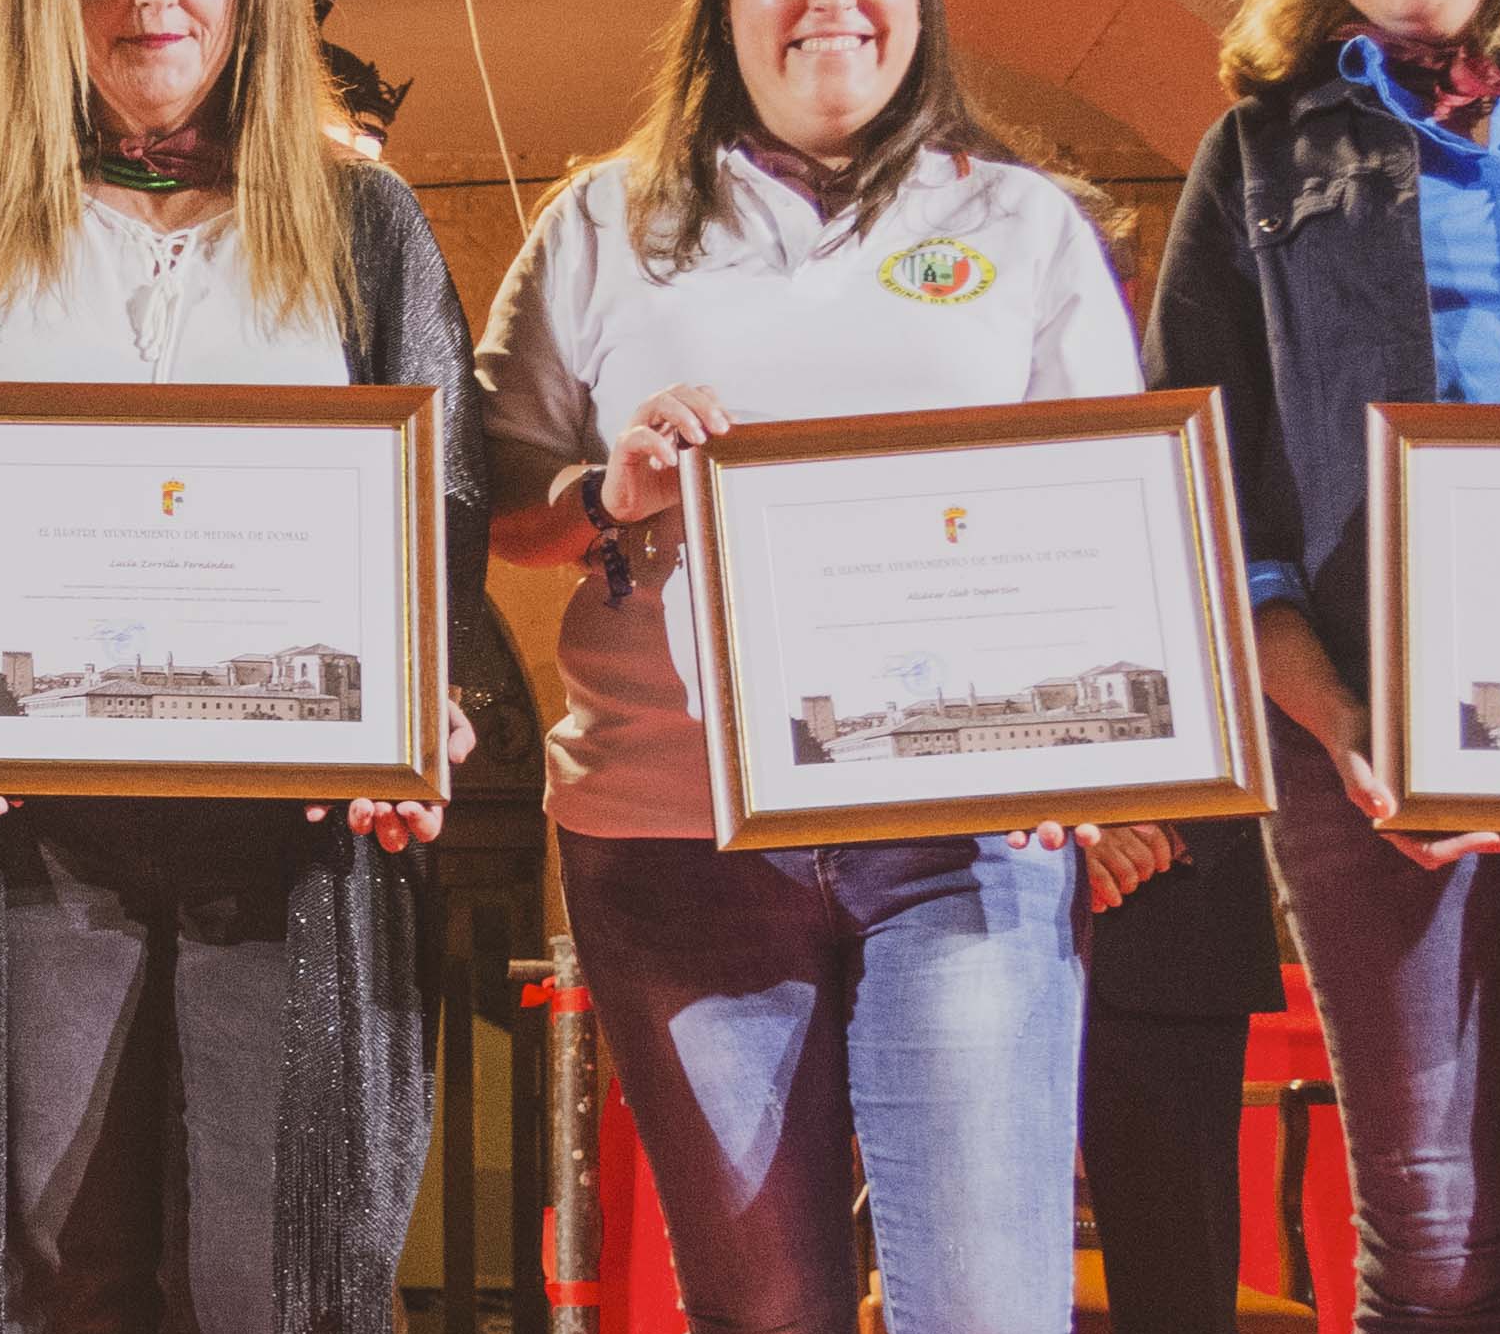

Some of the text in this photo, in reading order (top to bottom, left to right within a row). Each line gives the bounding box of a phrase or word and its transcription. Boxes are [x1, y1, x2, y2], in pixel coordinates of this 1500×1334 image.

[882, 278, 990, 305] MEDINA DE POMAR
[38, 527, 49, 538] EL
[103, 528, 181, 539] AYUNTAMIENTO
[184, 529, 200, 540] DE
[203, 529, 244, 540] MEDINA
[247, 530, 264, 541] DE
